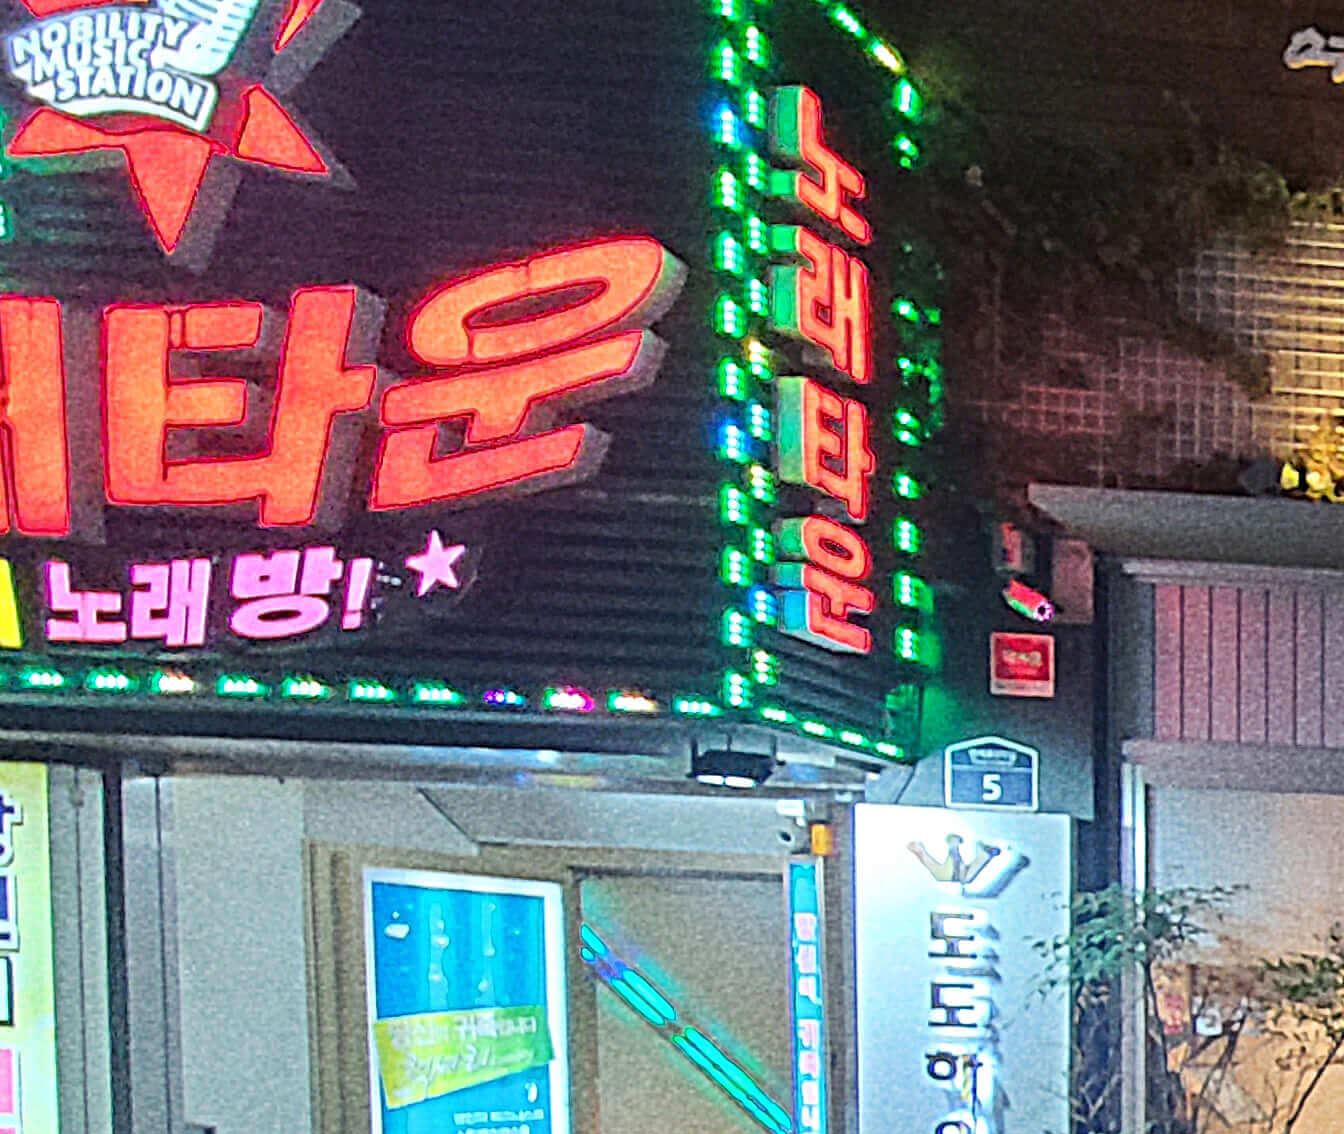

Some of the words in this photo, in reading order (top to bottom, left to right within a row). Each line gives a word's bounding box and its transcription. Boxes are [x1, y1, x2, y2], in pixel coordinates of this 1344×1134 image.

[11, 11, 189, 65] NOBILITY
[31, 38, 154, 83] MUSIC
[55, 66, 203, 118] STATION
[797, 85, 876, 654] 노래타운
[982, 773, 1002, 801] 5
